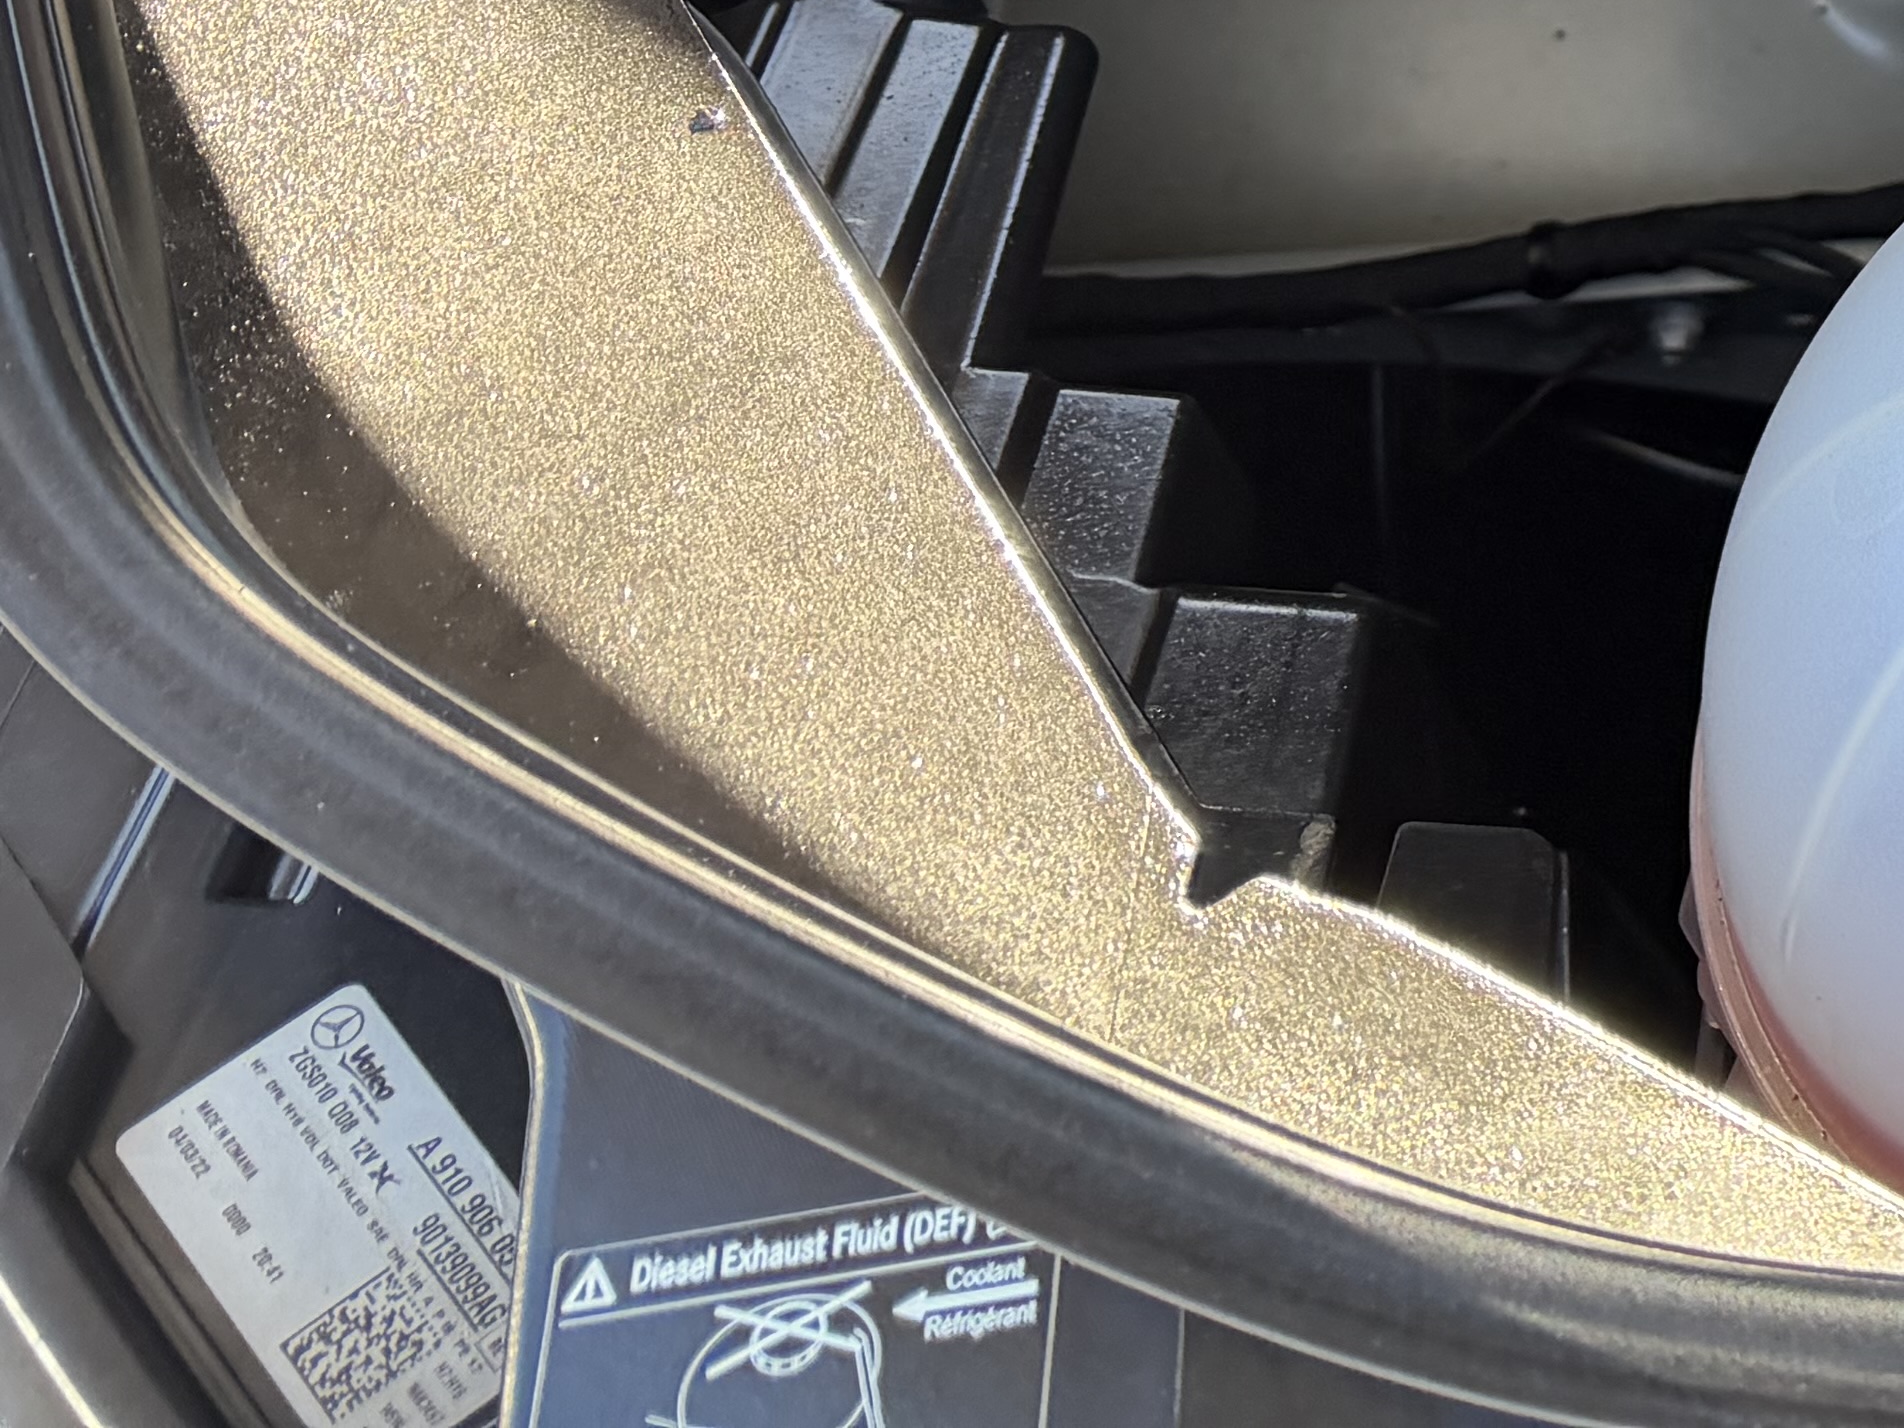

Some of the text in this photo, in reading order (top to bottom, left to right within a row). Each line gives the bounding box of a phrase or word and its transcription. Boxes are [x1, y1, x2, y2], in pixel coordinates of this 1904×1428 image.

[347, 1042, 398, 1105] Valeo
[219, 1135, 260, 1183] ROMANIA
[347, 1134, 381, 1169] 12V
[414, 1131, 445, 1160] A
[334, 1176, 370, 1218] VALEO
[429, 1151, 474, 1199] 910
[459, 1192, 504, 1239] 906
[630, 1245, 714, 1294] Diesel
[720, 1229, 826, 1278] Exhaust
[832, 1213, 898, 1259] Fluid
[946, 1257, 1026, 1291] Coolant
[924, 1299, 1038, 1342] Réfrigérant
